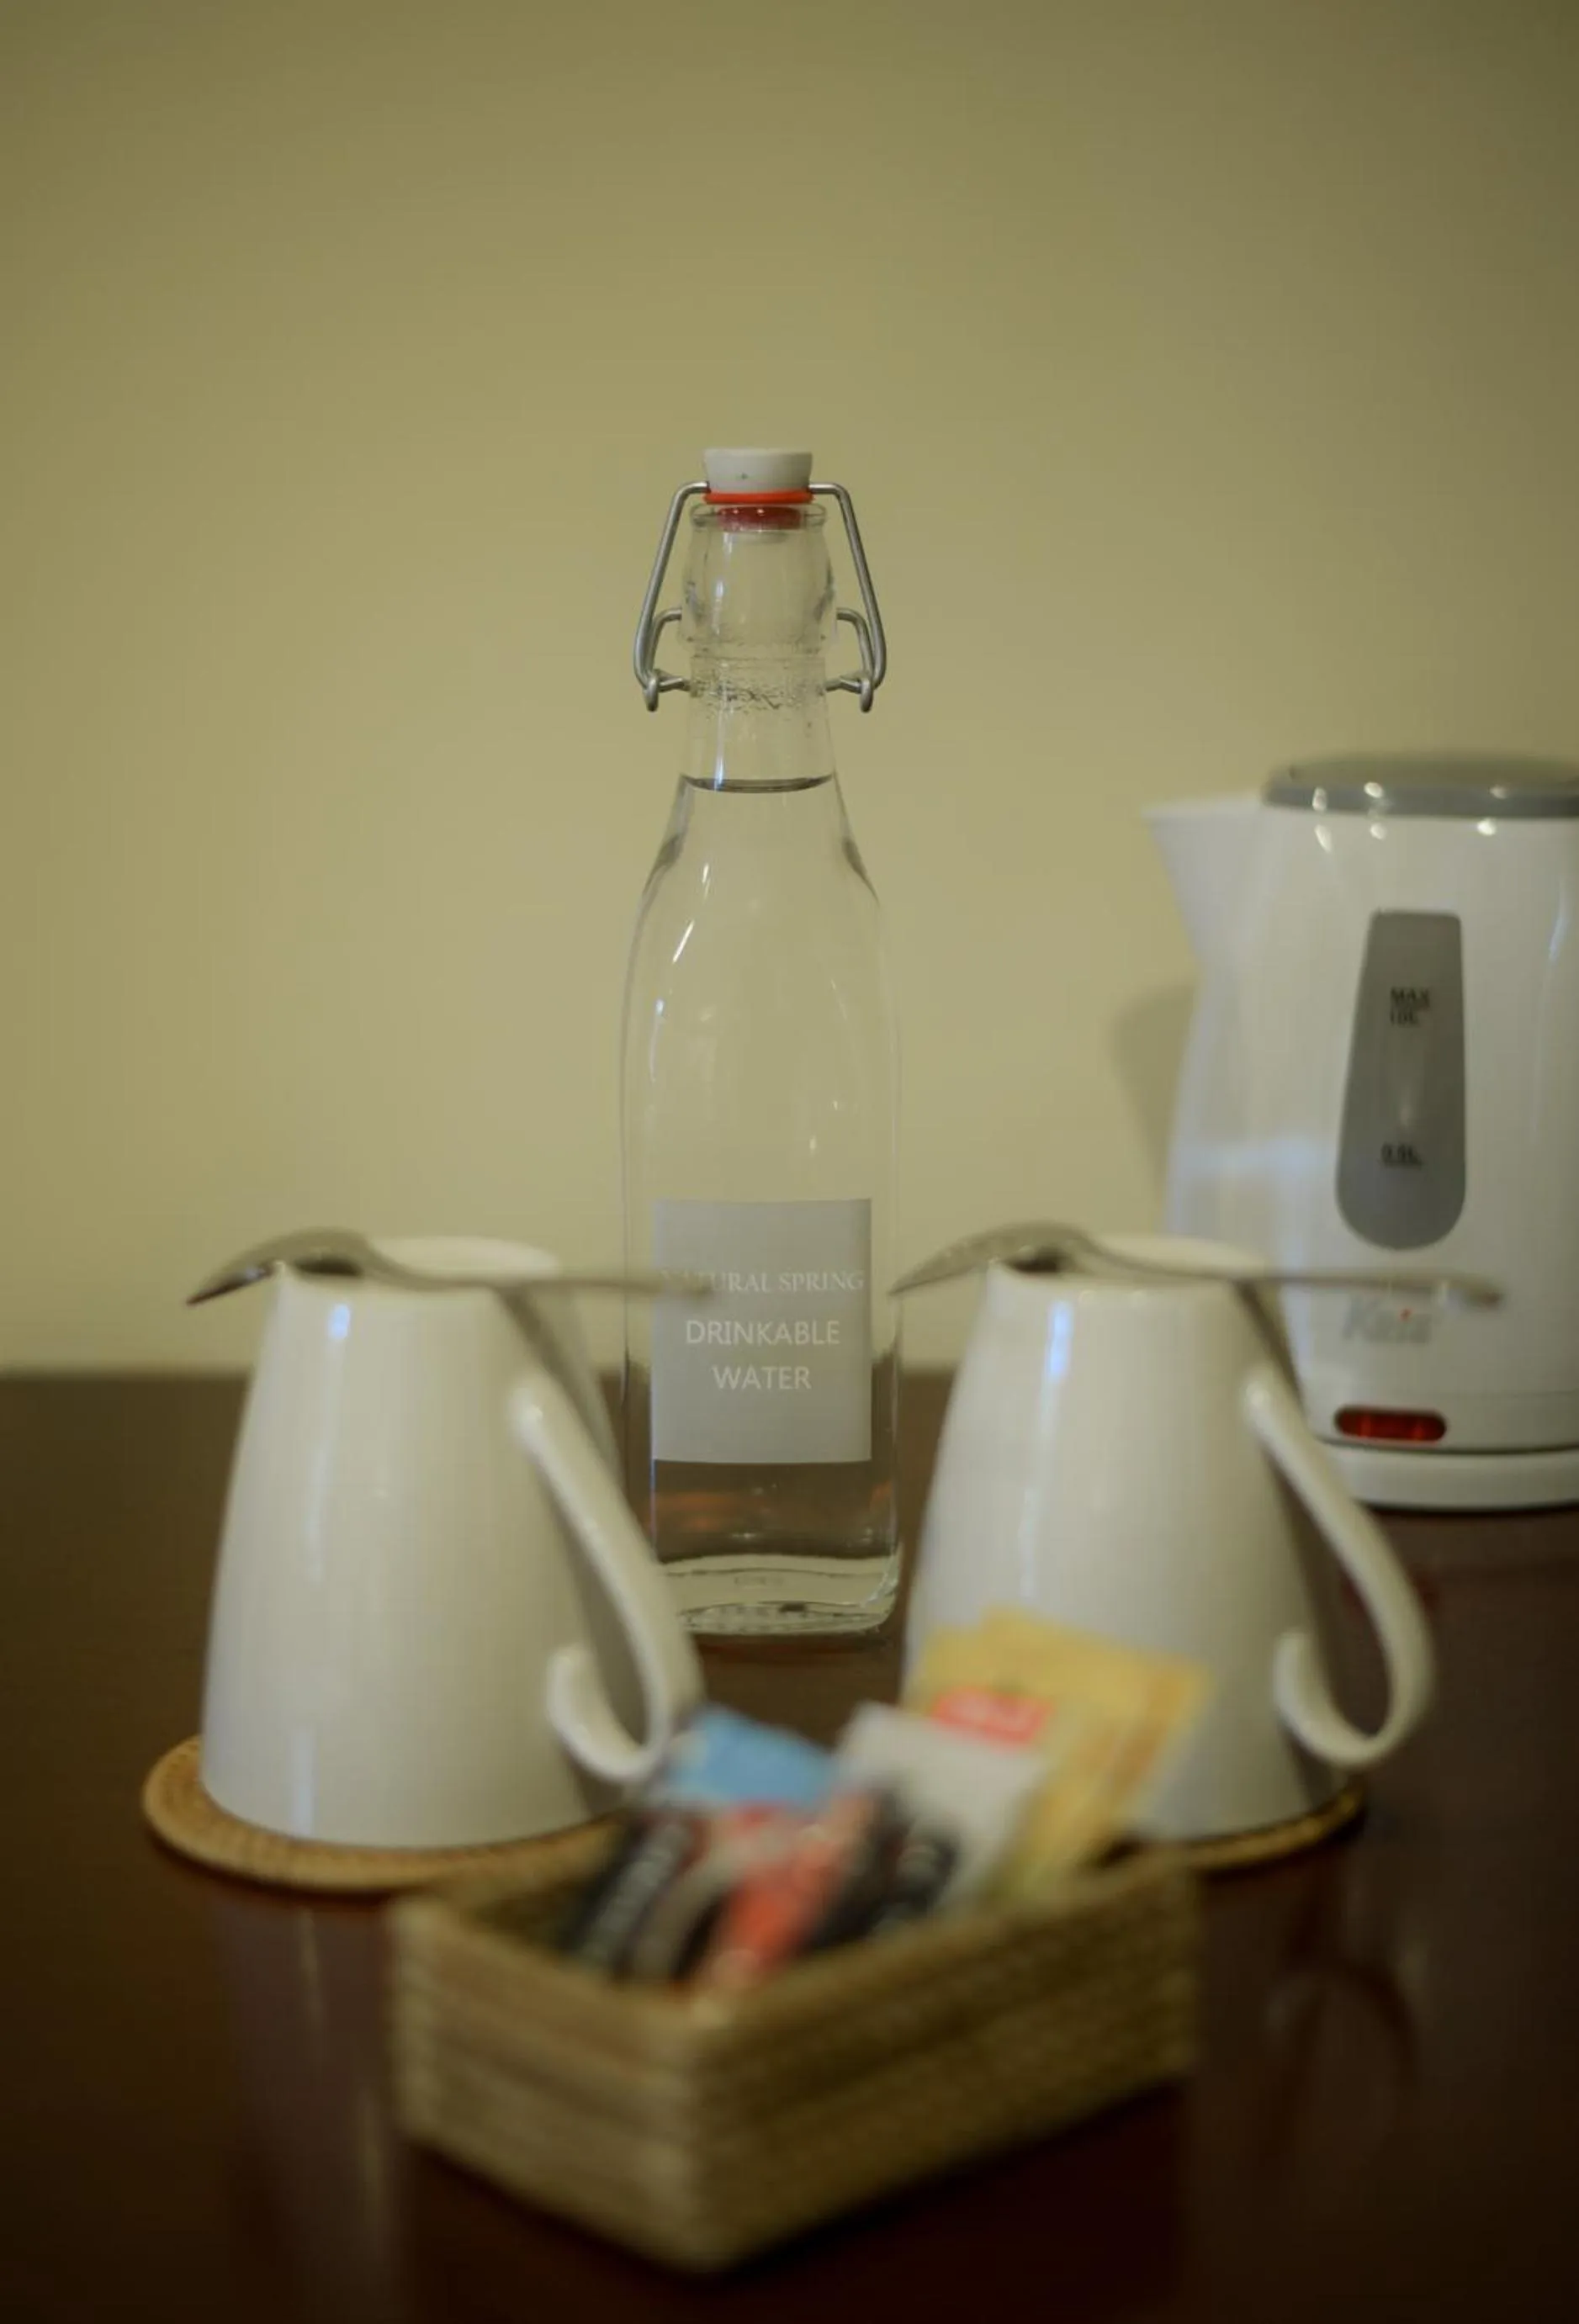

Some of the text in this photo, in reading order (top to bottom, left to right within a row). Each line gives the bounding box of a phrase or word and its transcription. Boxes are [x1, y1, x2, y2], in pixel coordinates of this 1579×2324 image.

[1390, 987, 1430, 1008] MAX
[778, 1270, 865, 1292] SPRING
[685, 1319, 841, 1346] DRINKABLE
[712, 1364, 813, 1390] WATER
